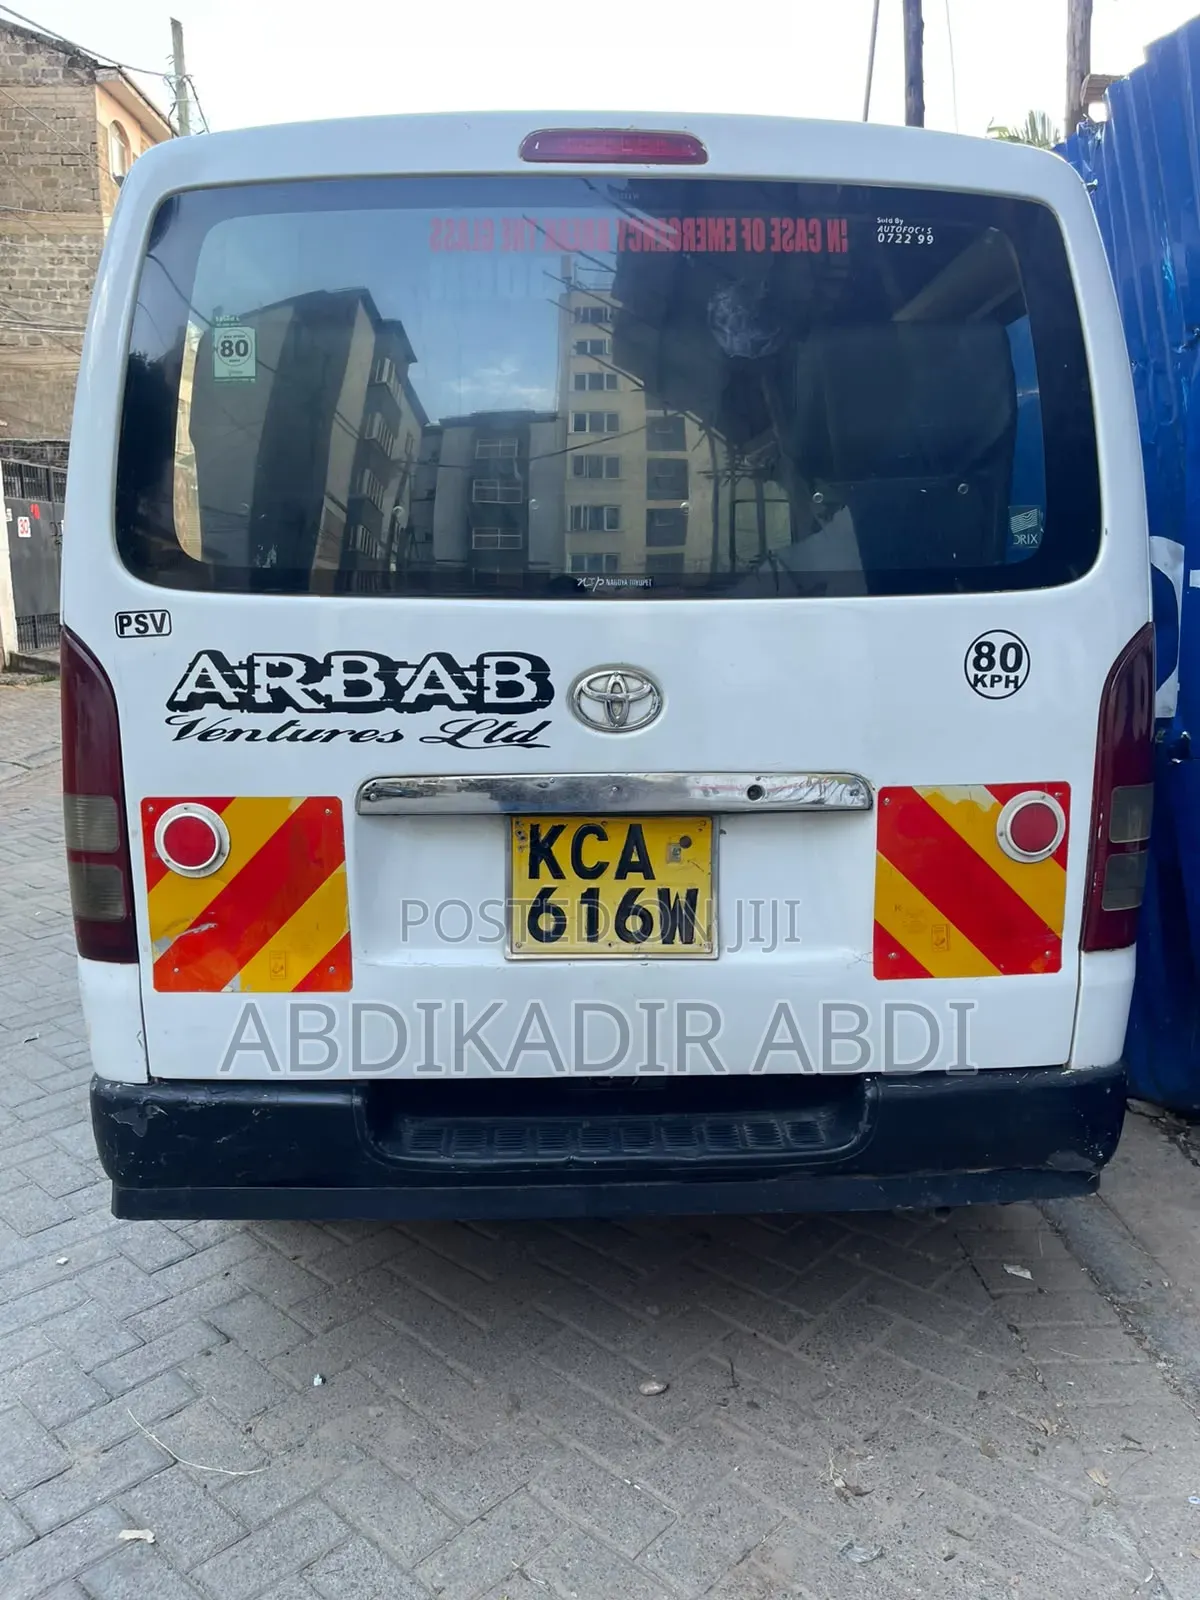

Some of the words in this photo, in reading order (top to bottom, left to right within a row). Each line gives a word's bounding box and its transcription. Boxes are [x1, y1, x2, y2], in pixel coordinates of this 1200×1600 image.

[895, 217, 903, 225] By
[877, 232, 911, 243] 0722
[917, 234, 934, 244] 99
[220, 340, 249, 357] 80
[118, 612, 167, 635] PSV
[972, 641, 1023, 673] 80
[166, 649, 555, 714] ARBAB
[973, 674, 1019, 689] KPH
[165, 714, 404, 743] Ventures
[419, 718, 552, 750] Ltd
[528, 823, 656, 880] KCA
[527, 887, 699, 945] 616W
